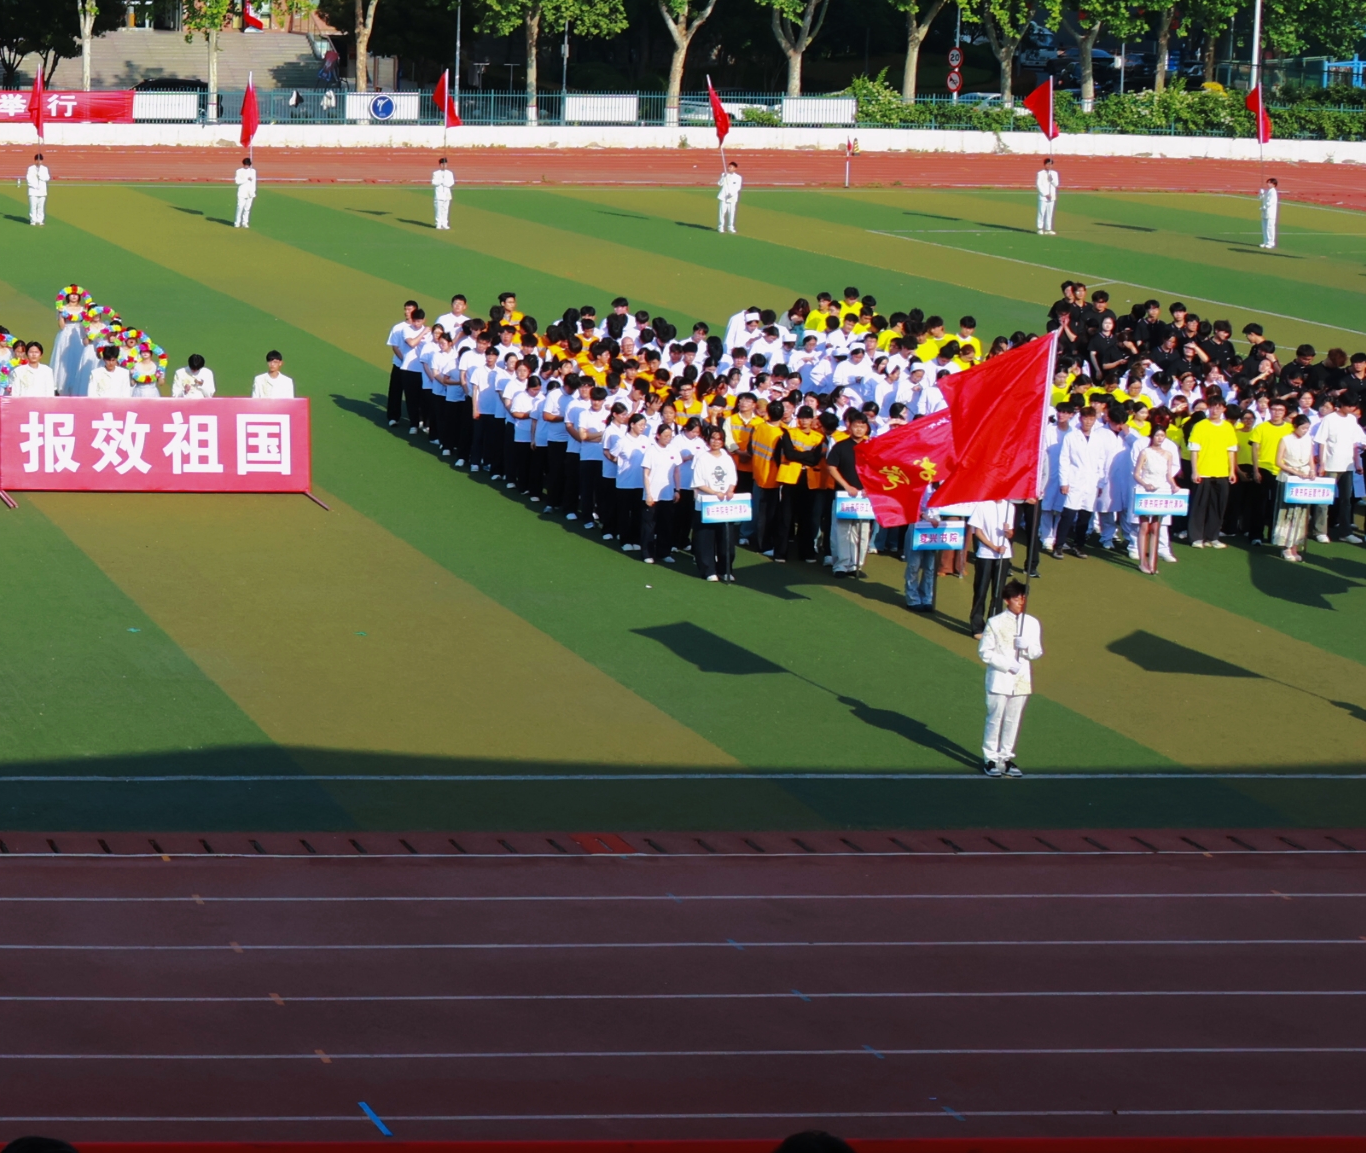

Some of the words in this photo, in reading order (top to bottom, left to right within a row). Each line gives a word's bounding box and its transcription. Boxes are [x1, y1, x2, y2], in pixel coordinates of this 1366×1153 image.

[950, 53, 960, 62] 20
[19, 410, 292, 477] 报效祖国
[920, 532, 958, 544] 复兴书院
